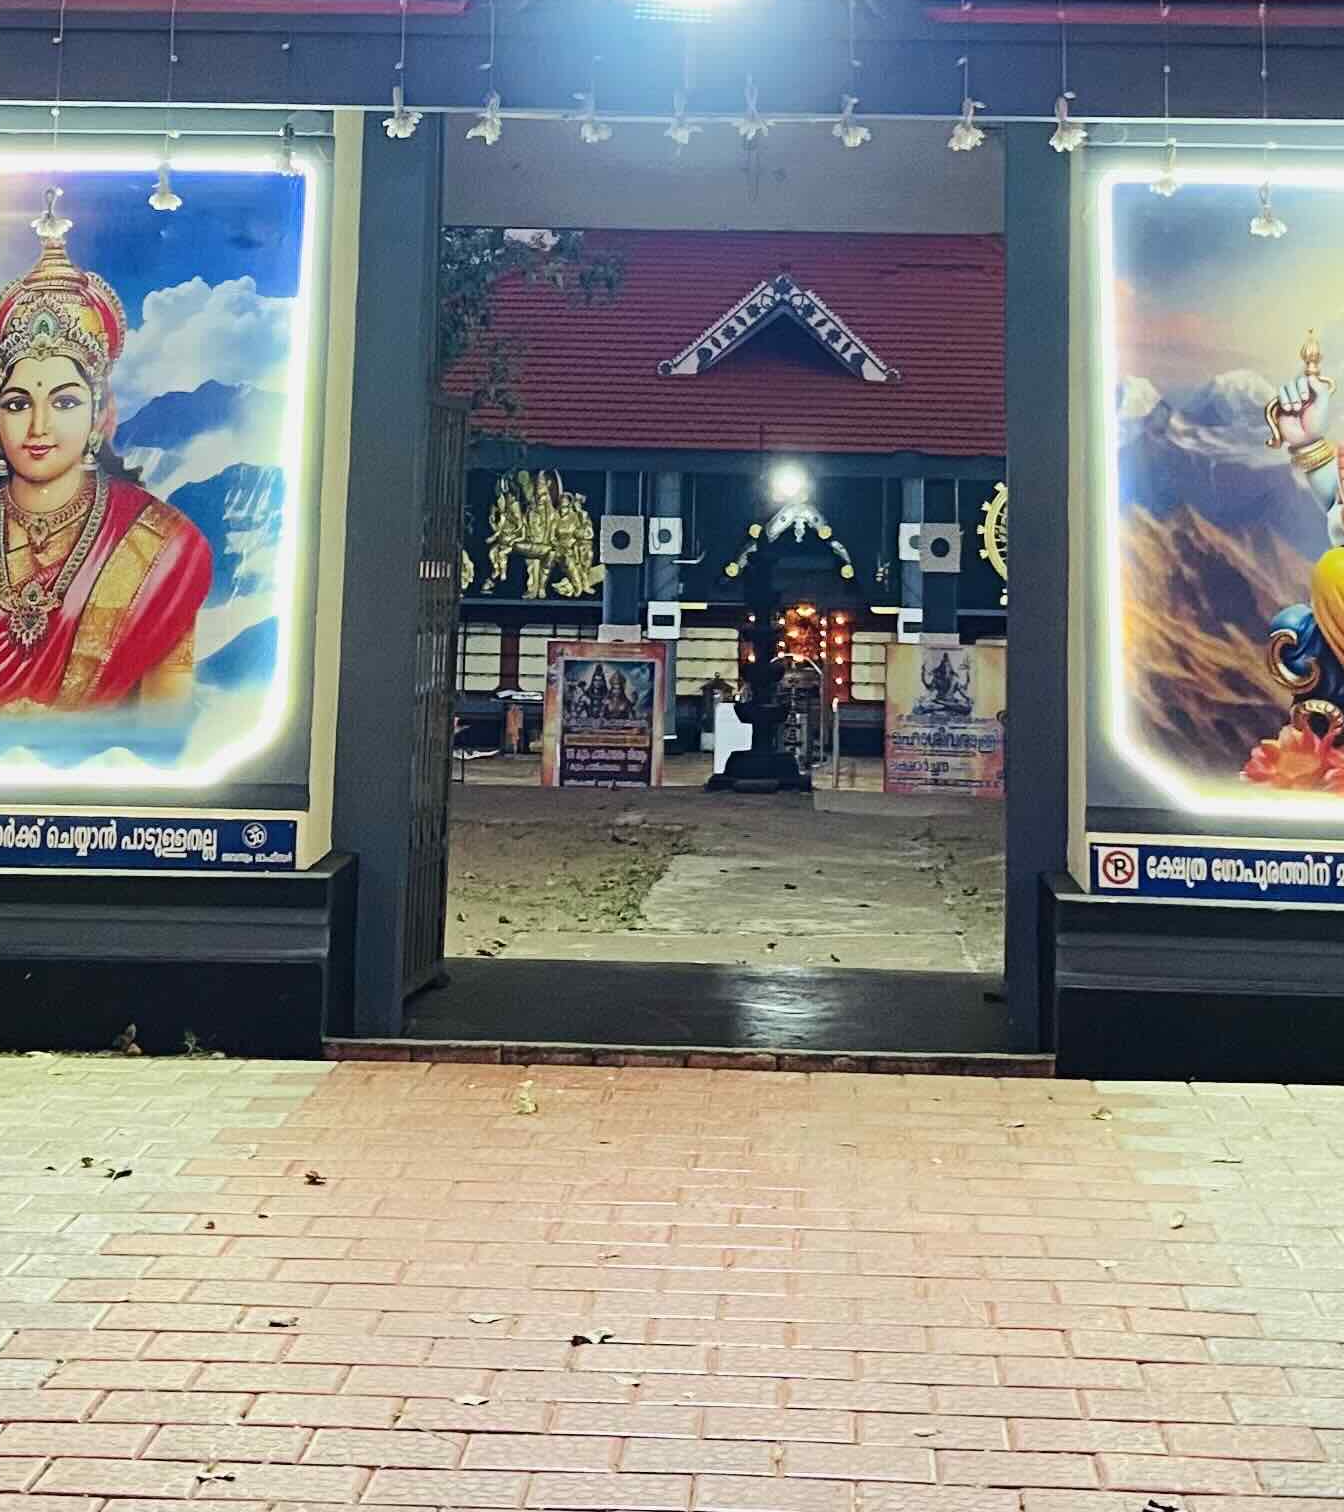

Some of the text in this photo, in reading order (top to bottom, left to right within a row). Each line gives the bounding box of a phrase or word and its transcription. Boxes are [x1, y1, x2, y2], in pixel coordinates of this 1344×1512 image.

[46, 819, 117, 857] ചെയ്യാൻ
[120, 826, 217, 861] പാടുള്ളതല്ല
[1146, 855, 1207, 888] ക്ഷേത്ര
[1211, 854, 1333, 891] ഗോപുരത്തിന്
